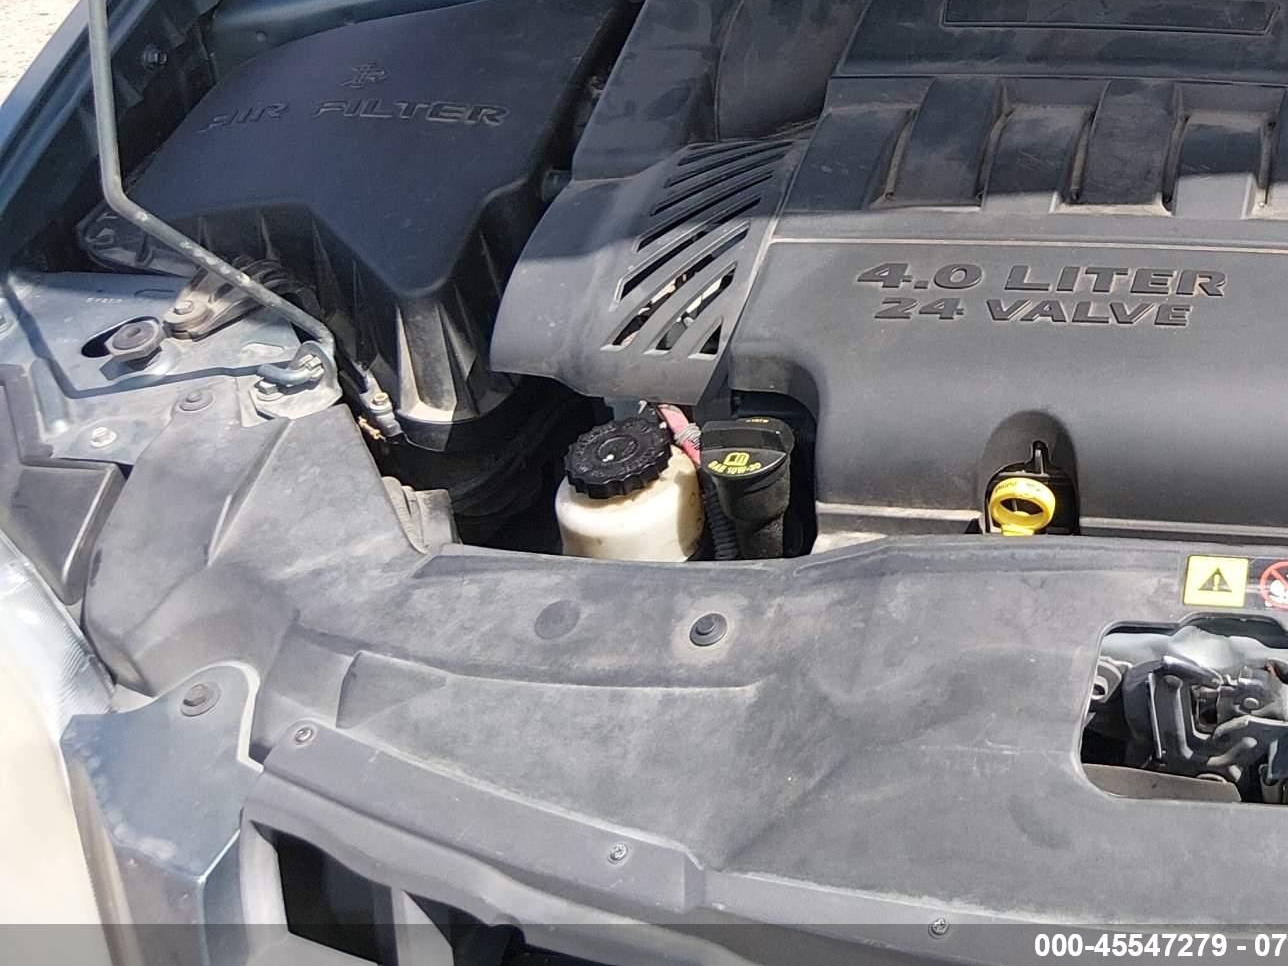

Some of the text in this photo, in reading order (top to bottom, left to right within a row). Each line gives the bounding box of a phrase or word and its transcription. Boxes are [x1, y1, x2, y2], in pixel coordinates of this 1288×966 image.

[199, 98, 508, 132] AIR FILTER
[857, 263, 1228, 297] 4.0 LITER
[875, 297, 1193, 327] 24 VALVE
